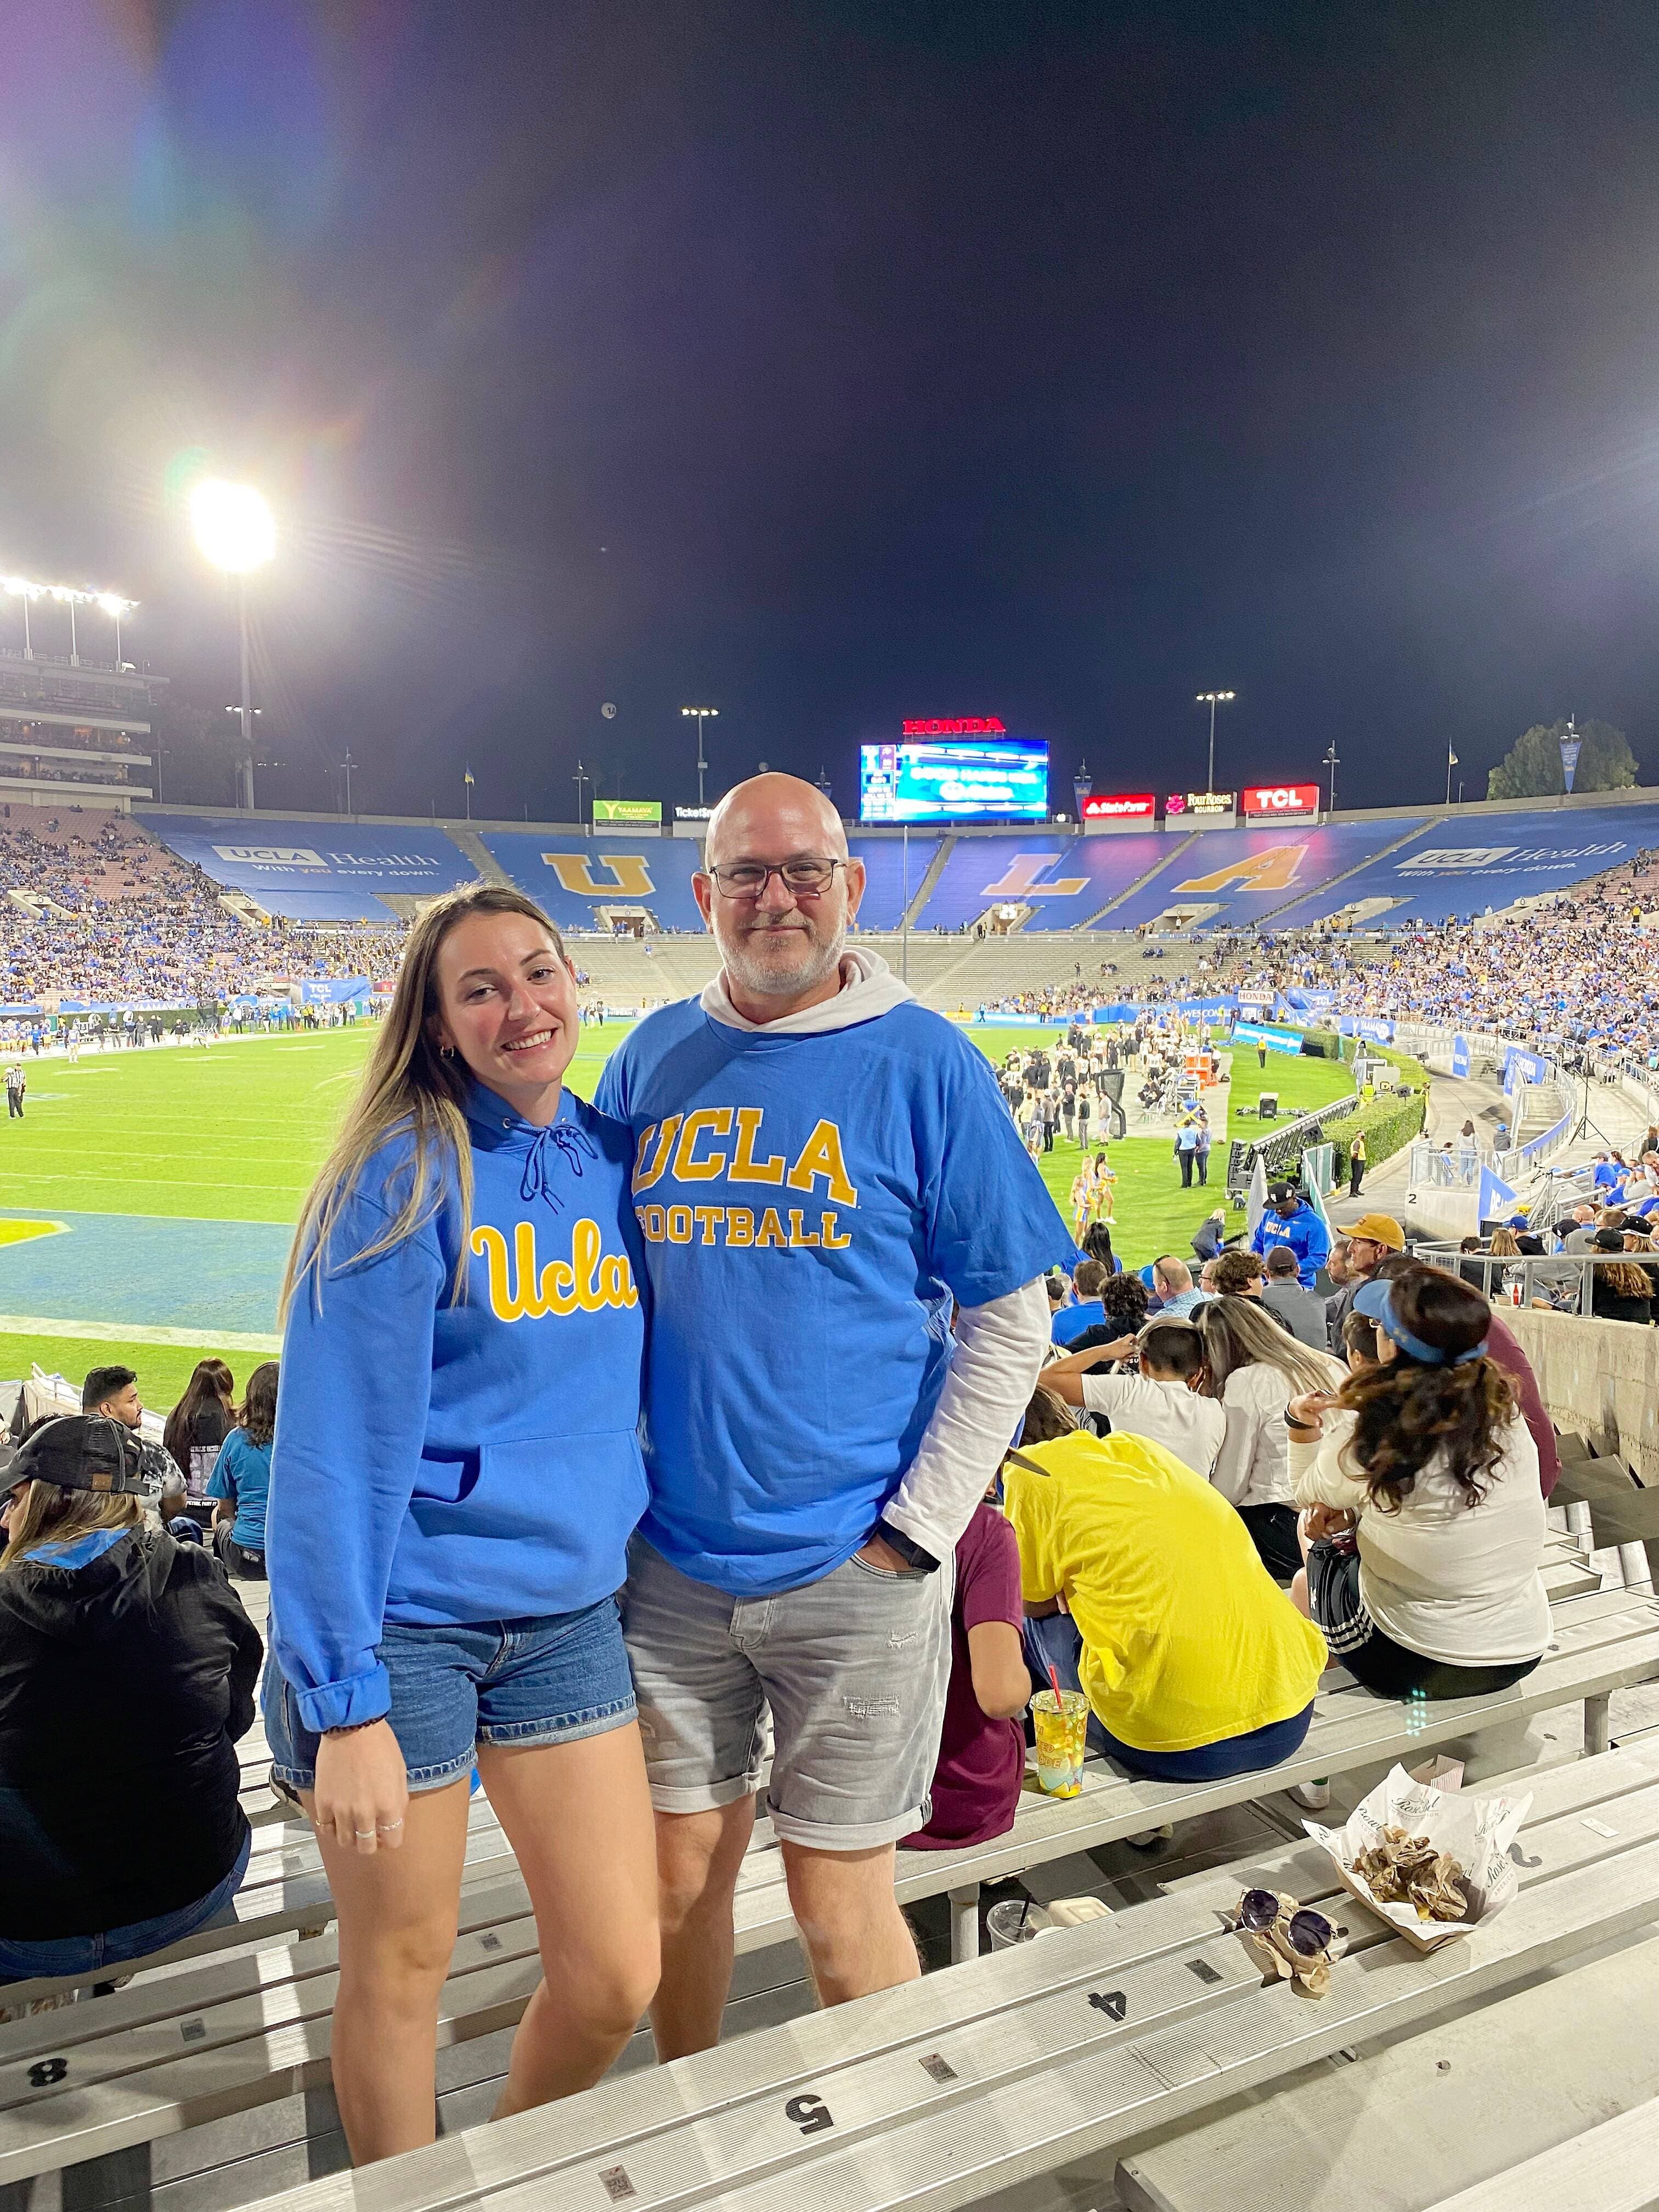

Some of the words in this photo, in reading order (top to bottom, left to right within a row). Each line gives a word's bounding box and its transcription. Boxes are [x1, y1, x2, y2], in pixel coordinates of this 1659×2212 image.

[903, 717, 1006, 735] HONDA
[1256, 789, 1302, 808] TCL
[230, 848, 311, 862] UCLA
[326, 852, 439, 865] Health
[1418, 852, 1492, 864] UCLA
[1503, 841, 1628, 862] Health
[251, 864, 295, 873] With
[337, 868, 383, 876] every
[540, 853, 657, 897] U
[980, 853, 1091, 896] L
[1170, 844, 1310, 893] A
[1398, 869, 1435, 878] With
[1471, 867, 1522, 875] every
[1523, 862, 1577, 872] down.
[309, 983, 332, 993] TCL
[1239, 992, 1272, 1001] HONDA
[1316, 995, 1331, 1006] TCL
[632, 1106, 859, 1209] UCLA
[1408, 1193, 1417, 1204] 2
[470, 1218, 639, 1323] Ucla
[1088, 1990, 1128, 2022] 4
[27, 2057, 67, 2087] 8
[785, 2094, 834, 2135] 5
